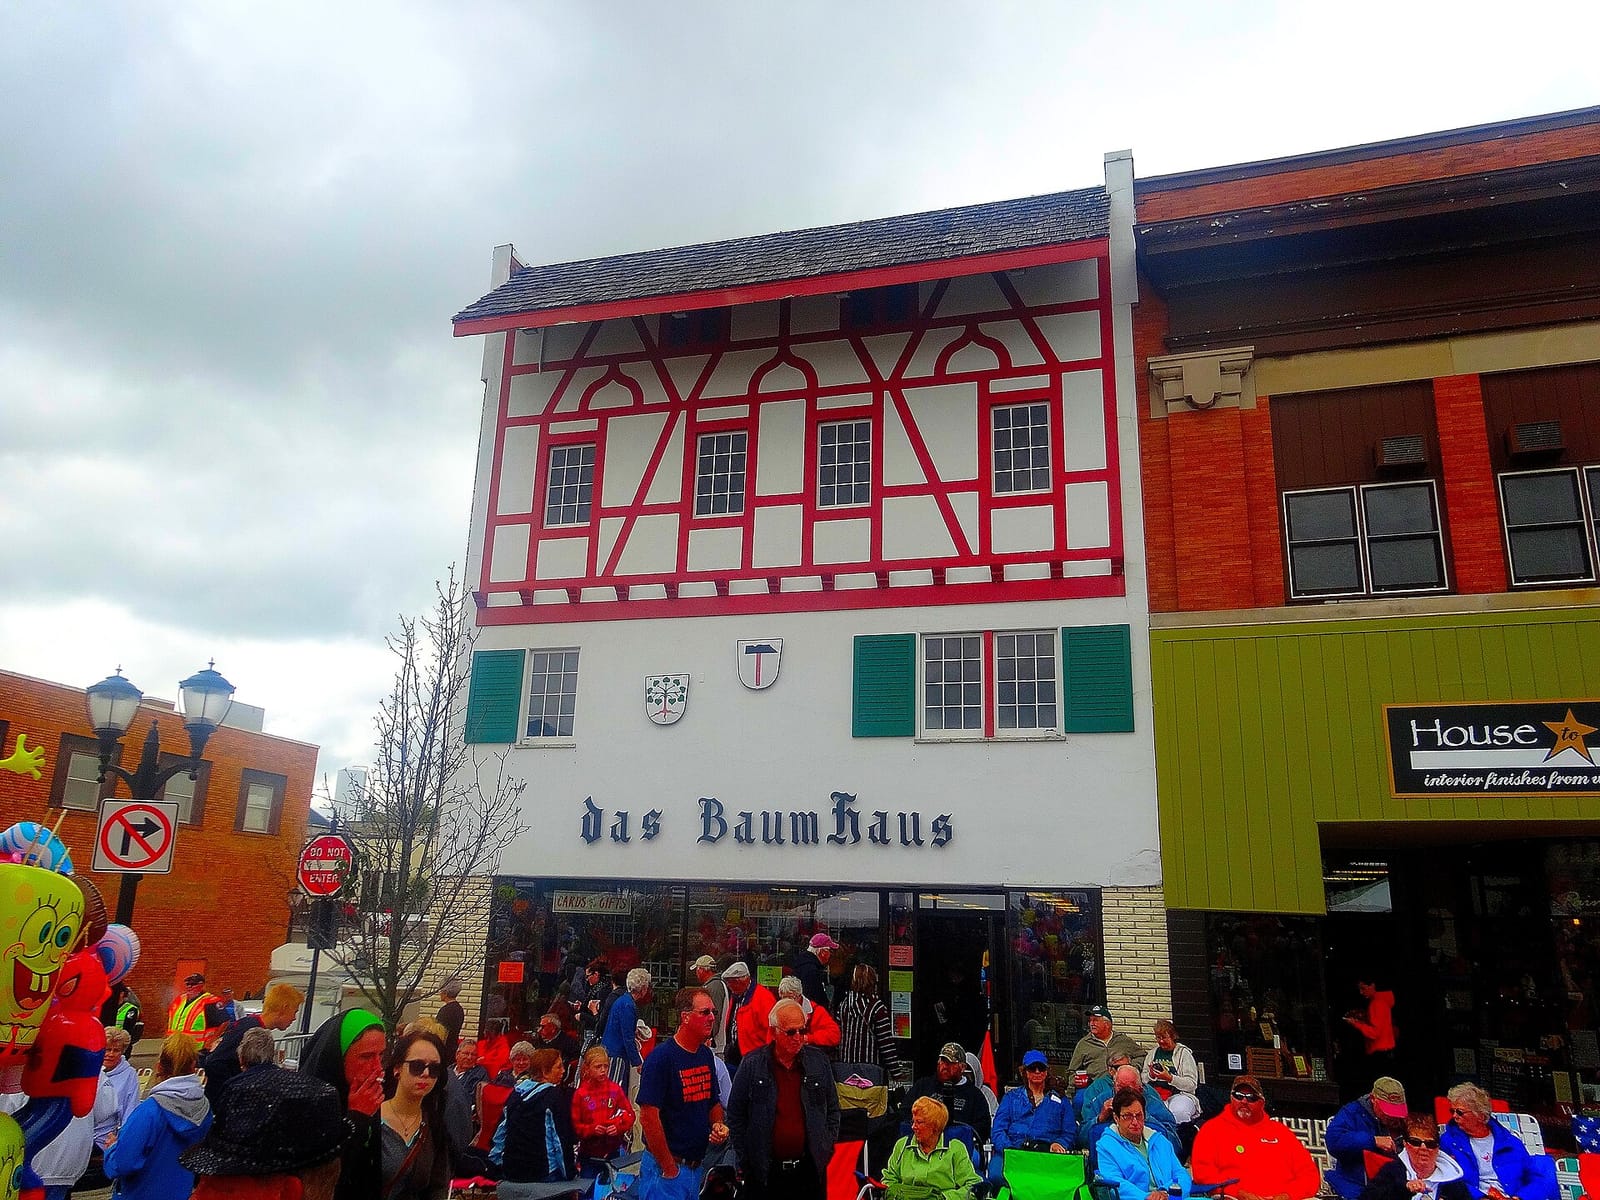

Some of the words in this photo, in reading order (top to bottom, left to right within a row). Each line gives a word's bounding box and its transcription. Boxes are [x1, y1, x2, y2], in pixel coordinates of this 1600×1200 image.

[1410, 718, 1538, 747] House
[1560, 726, 1580, 741] to
[1424, 774, 1484, 787] interior
[1484, 770, 1546, 790] finishes
[1547, 771, 1589, 789] from
[579, 795, 664, 845] das
[310, 848, 323, 857] DO
[327, 848, 345, 857] NOT
[309, 874, 338, 883] ENTER
[557, 895, 587, 908] CARDS
[600, 896, 627, 909] GIFTS
